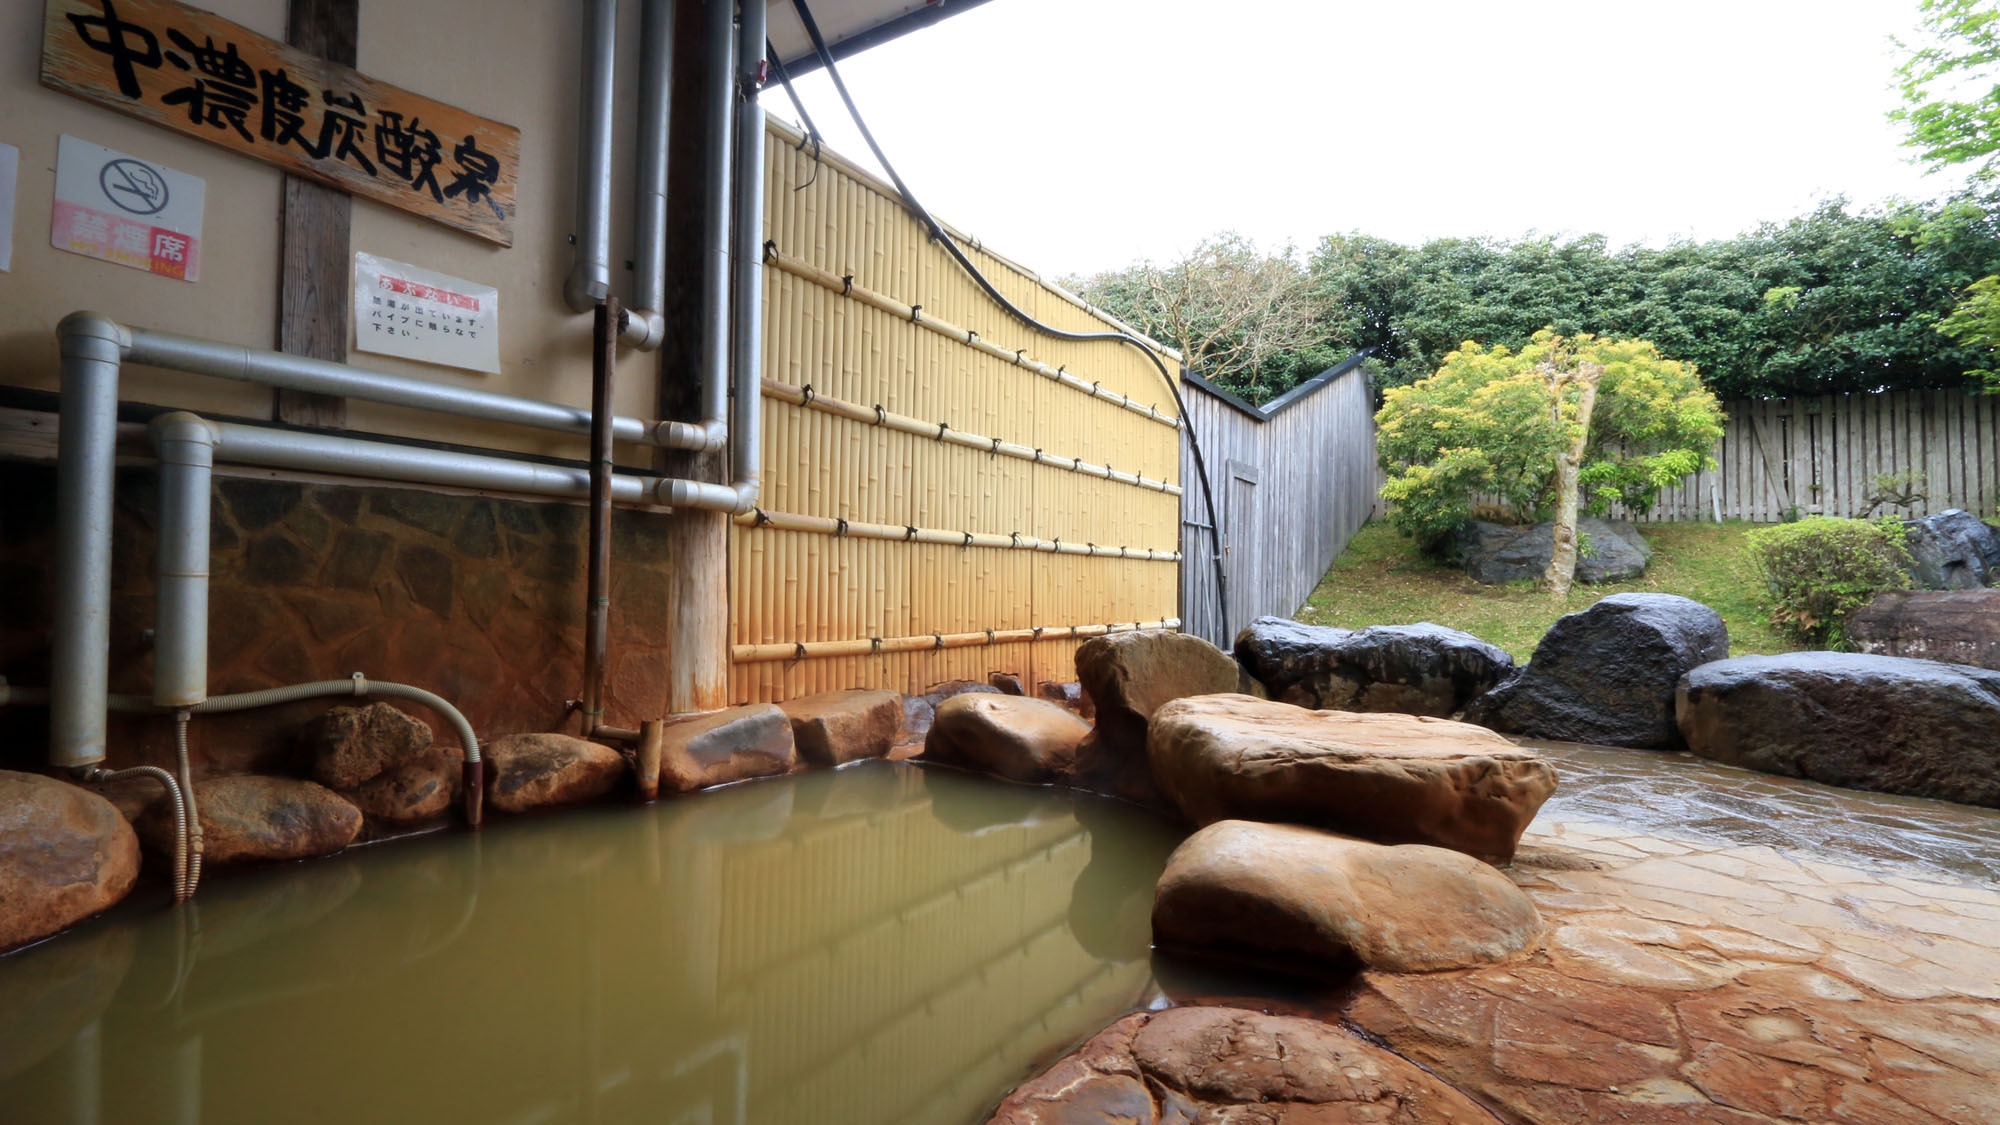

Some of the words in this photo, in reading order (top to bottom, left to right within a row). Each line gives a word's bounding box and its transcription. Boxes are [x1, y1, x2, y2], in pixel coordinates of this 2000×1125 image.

[66, 0, 506, 220] 中濃度炭酸泉
[72, 211, 186, 262] 禁煙席
